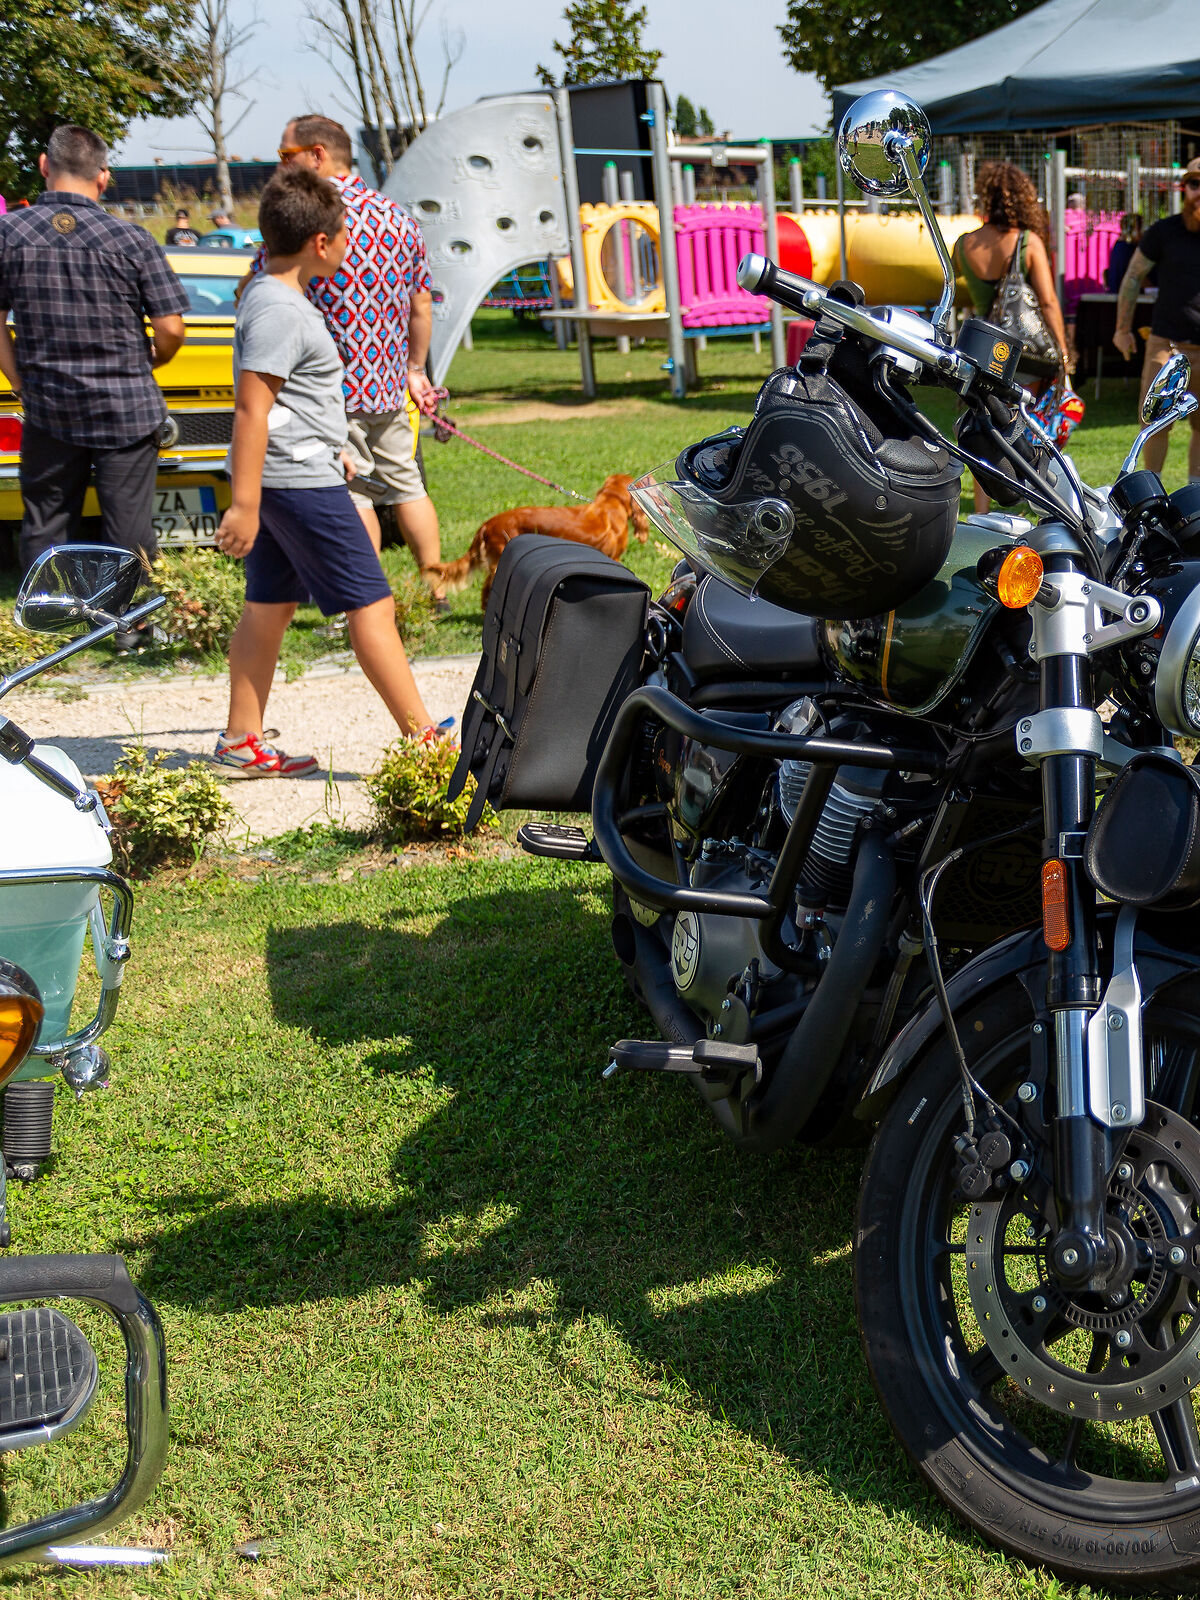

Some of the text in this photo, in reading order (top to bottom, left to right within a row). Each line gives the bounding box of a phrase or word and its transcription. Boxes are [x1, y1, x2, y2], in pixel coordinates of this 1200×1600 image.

[155, 491, 187, 512] ZA
[151, 515, 217, 538] 52 VD
